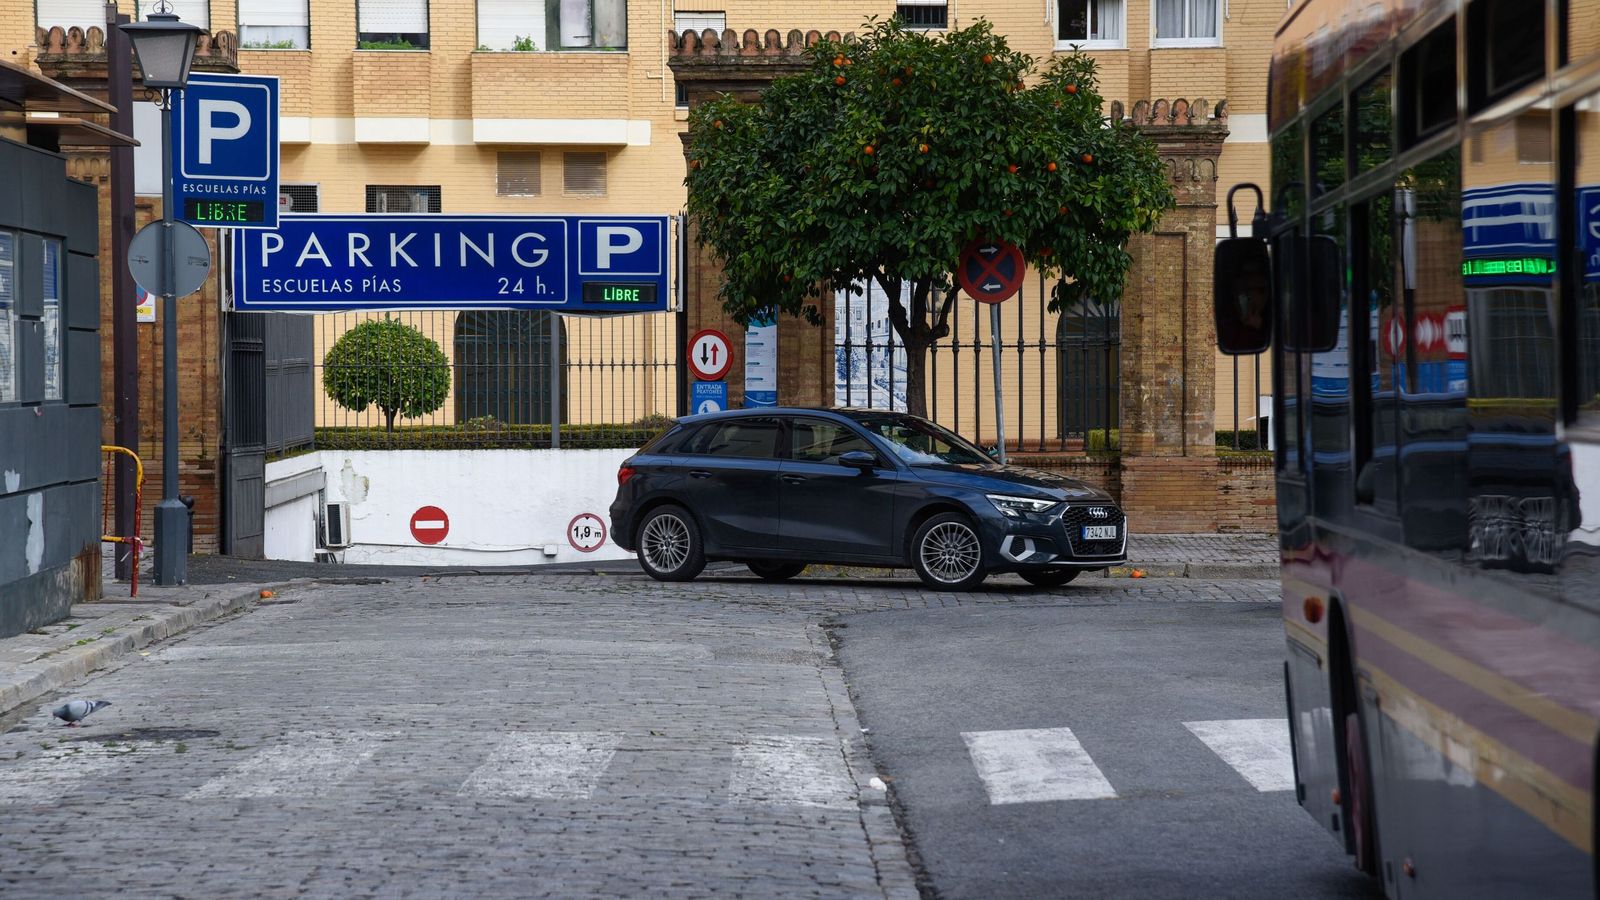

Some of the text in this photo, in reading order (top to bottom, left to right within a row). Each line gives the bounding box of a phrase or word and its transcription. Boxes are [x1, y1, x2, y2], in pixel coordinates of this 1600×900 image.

[198, 99, 252, 164] P
[182, 183, 267, 195] ESCUELAS PÍAS
[197, 203, 247, 221] LIBRE
[261, 231, 549, 268] PARKING
[596, 226, 643, 269] P
[262, 275, 402, 293] ESCUELAS PÍAS
[498, 275, 555, 295] 24 h.
[604, 287, 640, 301] LIBRE
[573, 526, 591, 540] 1,9
[1086, 527, 1103, 538] 7342
